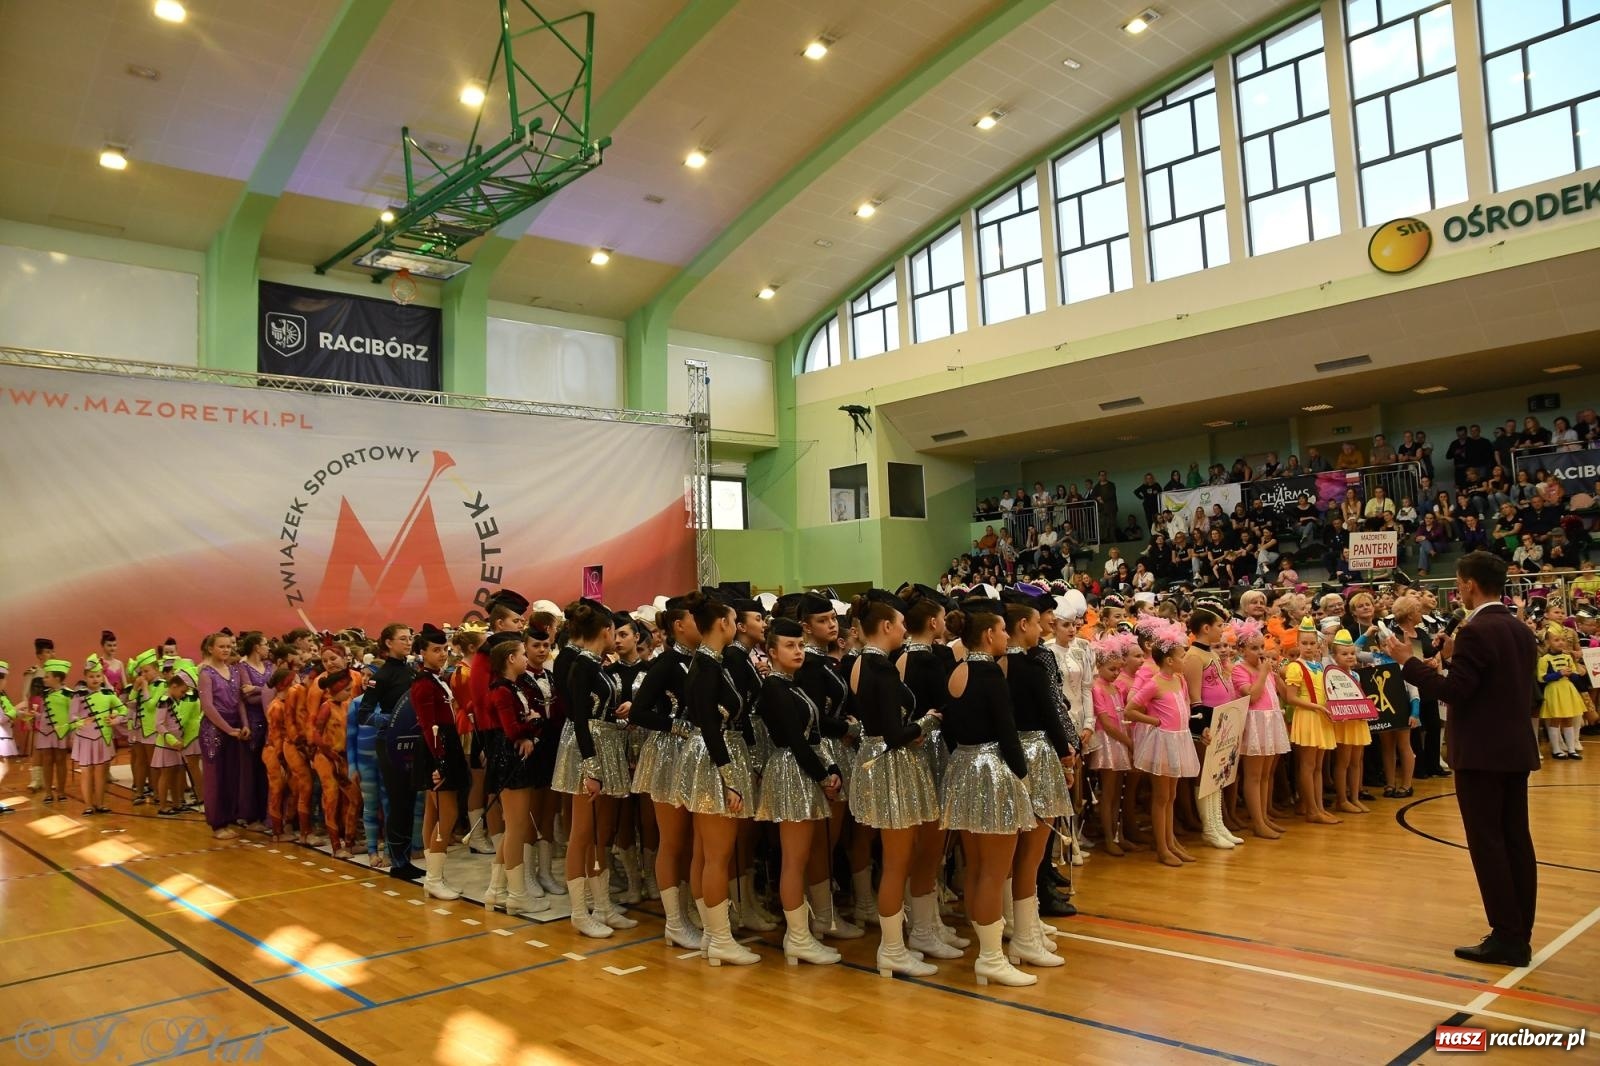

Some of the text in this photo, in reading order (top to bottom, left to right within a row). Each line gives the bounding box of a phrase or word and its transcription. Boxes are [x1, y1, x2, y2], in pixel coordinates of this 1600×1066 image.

[1443, 179, 1600, 243] OŚRODEK
[318, 332, 429, 362] RACIBÓRZ
[0, 387, 313, 430] WW.MAZORETKI.PL
[303, 445, 420, 496] SPORTOWY
[1549, 464, 1600, 480] ACIB
[279, 496, 309, 608] ZWIĄZEK
[1353, 542, 1394, 555] PANTERY
[1375, 558, 1394, 567] Poland
